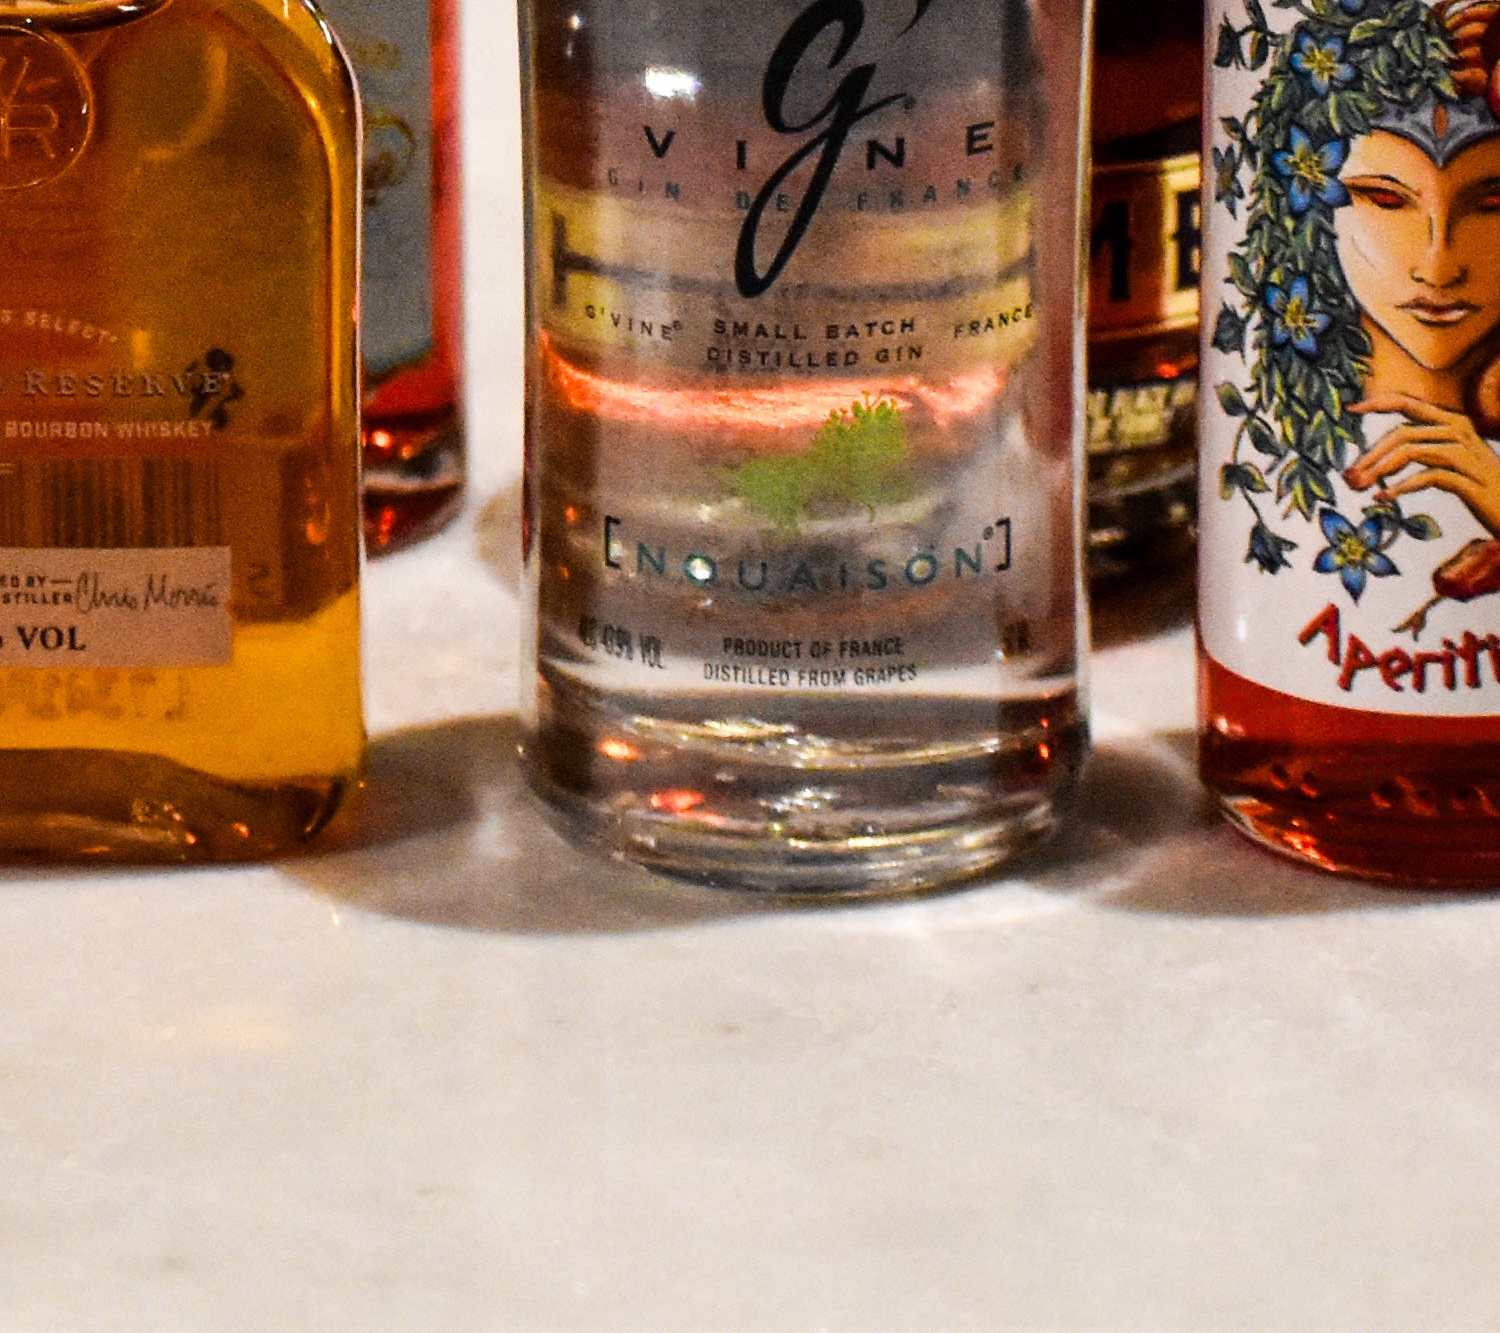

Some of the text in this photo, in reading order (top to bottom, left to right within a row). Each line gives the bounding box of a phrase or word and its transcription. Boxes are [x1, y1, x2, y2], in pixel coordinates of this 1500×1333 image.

[712, 317, 915, 341] SMALL BATCH
[953, 302, 1034, 339] FRANCE
[706, 345, 923, 368] DISTILLED GIN
[17, 624, 87, 652] VOL
[723, 636, 905, 659] PRODUCT OF FRANCE
[703, 663, 917, 687] DISTILLED FROM GRAPES
